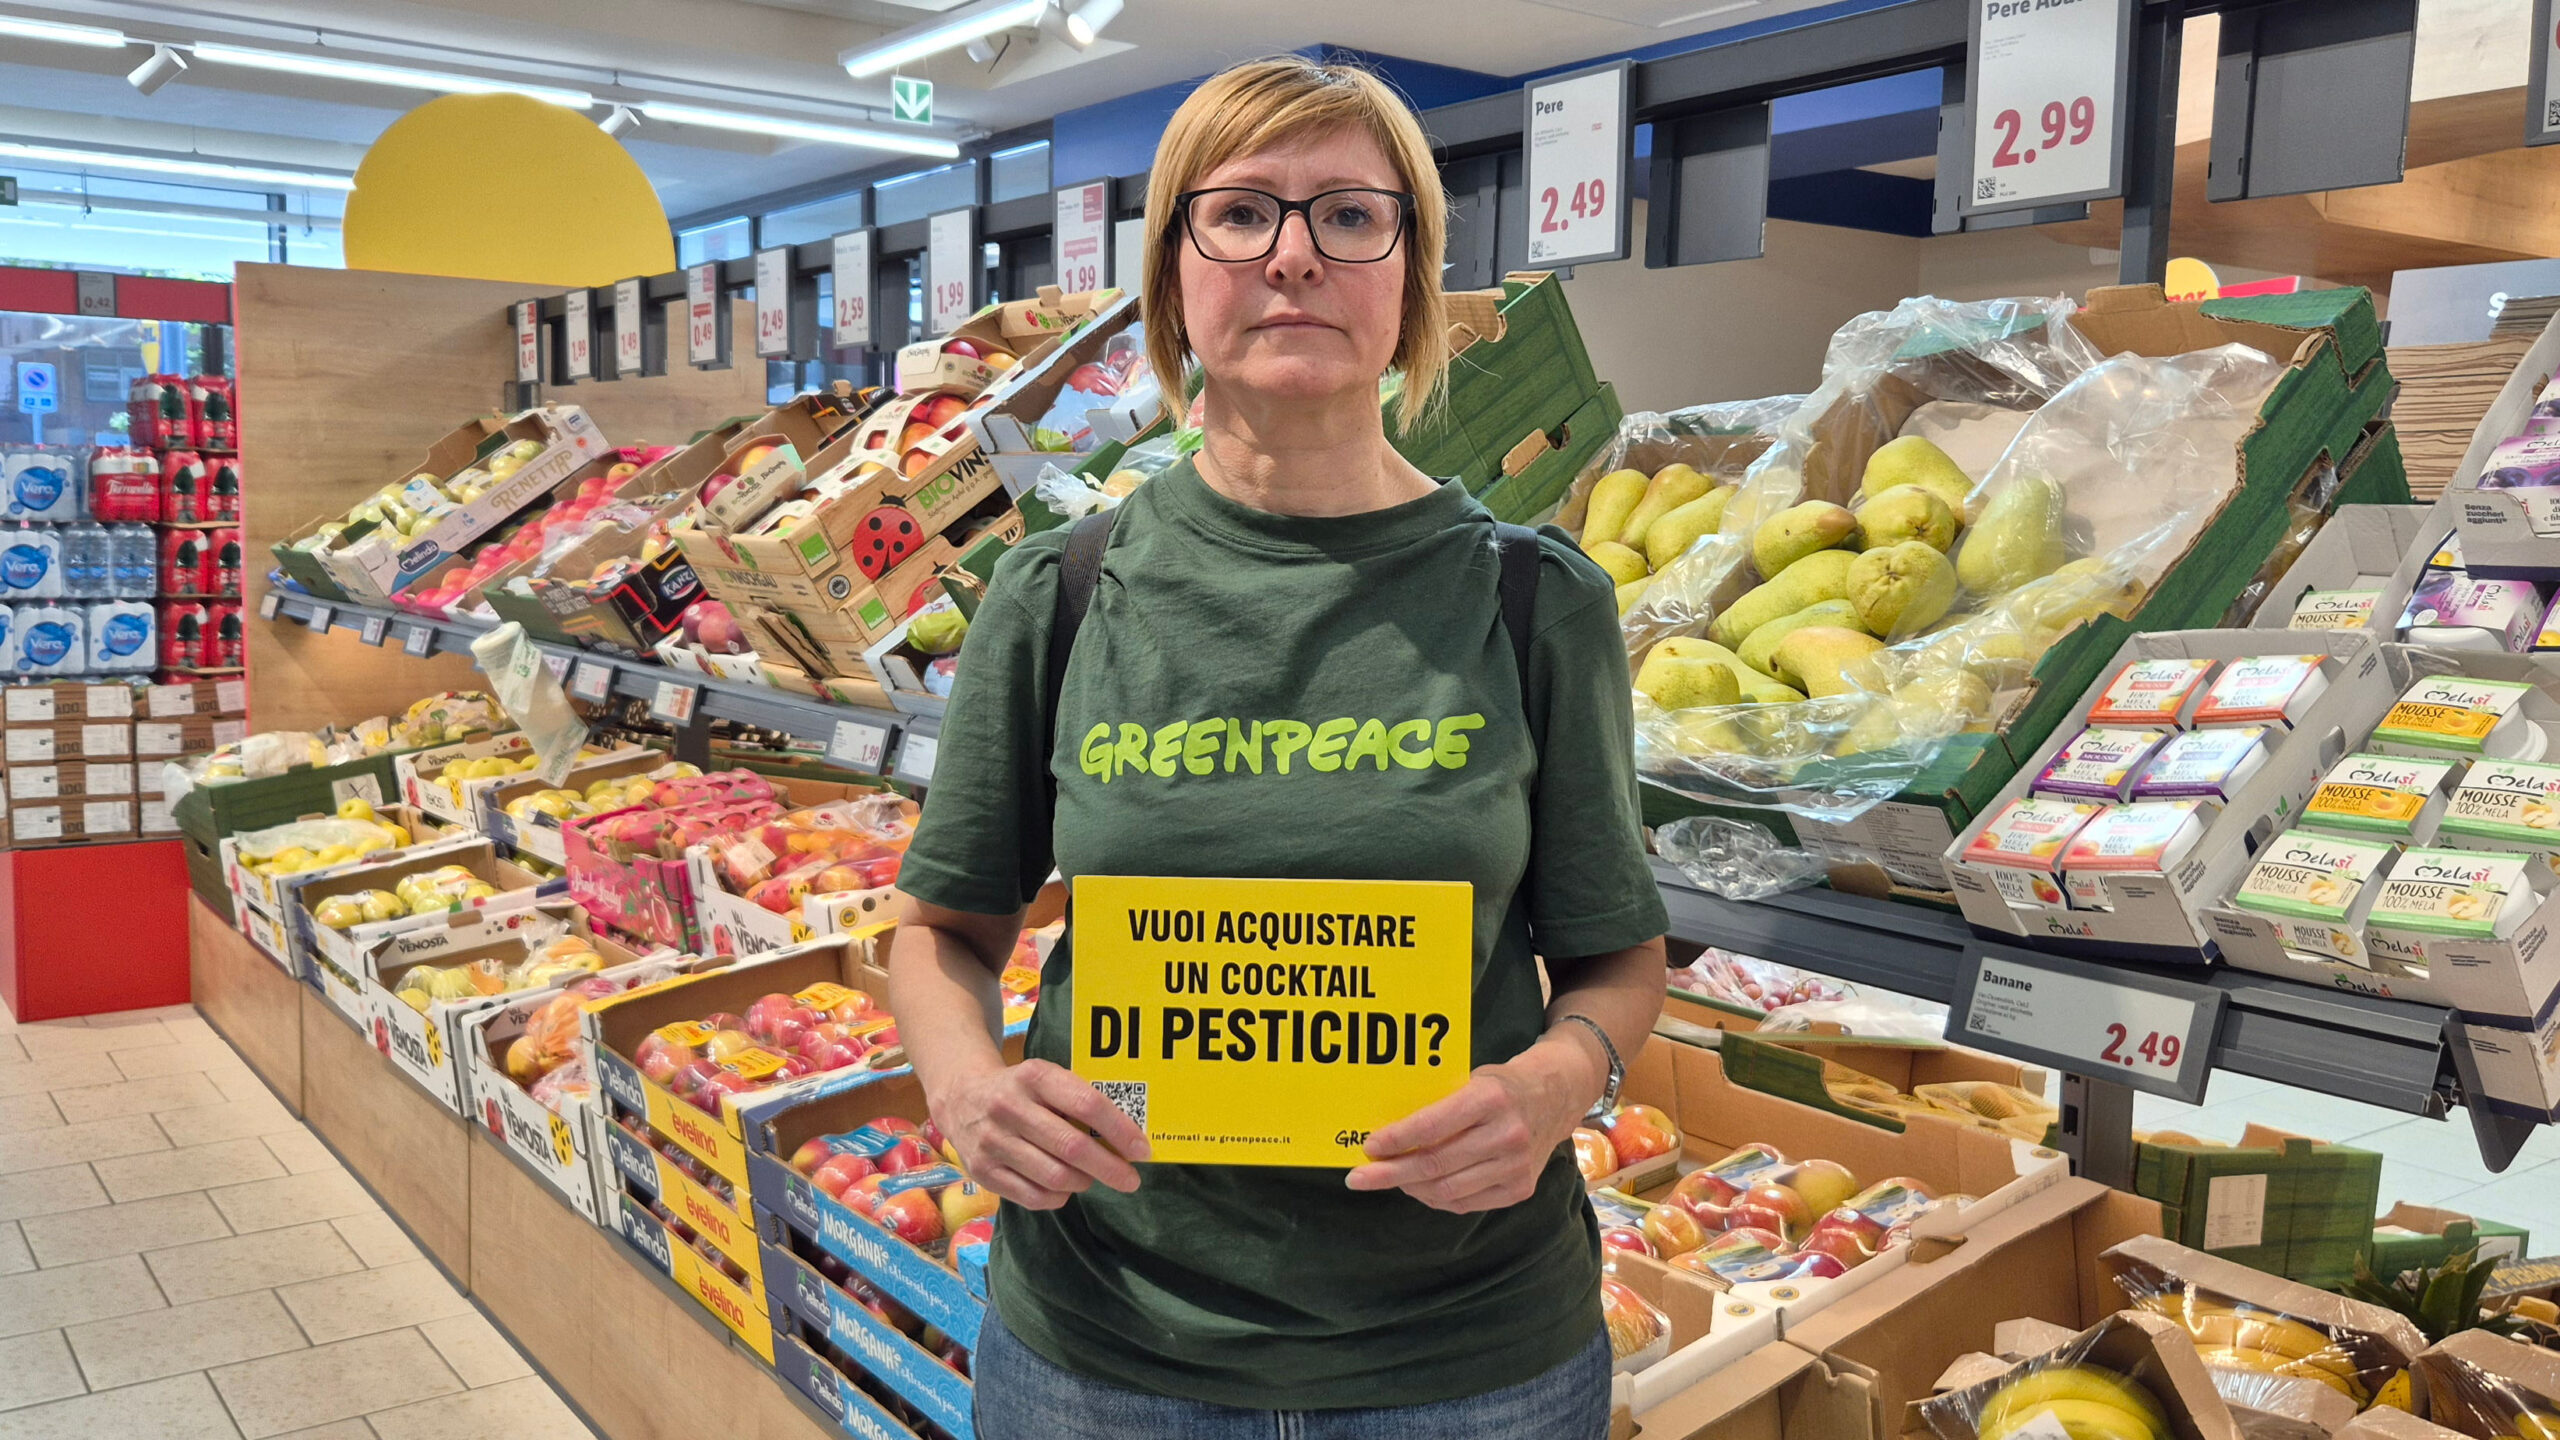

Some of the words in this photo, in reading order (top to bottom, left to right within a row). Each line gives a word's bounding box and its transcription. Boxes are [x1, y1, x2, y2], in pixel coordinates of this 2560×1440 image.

[1987, 0, 2030, 20] Pere
[1536, 100, 1563, 116] Pere
[1992, 96, 2095, 168] 2.99
[1540, 179, 1605, 233] 2.49
[1065, 265, 1096, 294] 1.99
[937, 281, 964, 314] 1.99
[762, 309, 784, 337] 2.49
[840, 296, 864, 327] 2.59
[621, 332, 637, 356] 1.49
[694, 322, 712, 346] 0.49
[572, 339, 586, 362] 1.99
[21, 481, 55, 494] Vera
[6, 560, 40, 573] Vera
[401, 540, 438, 570] Melinda
[664, 570, 696, 596] KANZI
[2296, 614, 2342, 624] MOUSSE
[31, 638, 65, 651] Vera
[109, 629, 142, 641] Vera
[2388, 713, 2414, 725] 100%
[2415, 716, 2435, 724] MELA
[2394, 703, 2450, 718] MOUSSE
[861, 743, 879, 763] 1.99
[1079, 712, 1486, 784] GREENPEACE
[2082, 753, 2121, 761] MOUSSE
[2320, 784, 2375, 801] MOUSSE
[2341, 797, 2362, 807] MELA
[2460, 789, 2521, 808] MOUSSE
[2455, 802, 2482, 816] 100%
[2484, 806, 2509, 819] MELA
[2002, 838, 2030, 847] MELA
[2251, 877, 2275, 892] 100%
[2277, 882, 2298, 895] MELA
[2256, 865, 2311, 884] MOUSSE
[1998, 882, 2025, 893] MELA
[2001, 890, 2024, 900] PESCA
[2386, 882, 2447, 900] MOUSSE
[2382, 895, 2408, 909] 100%
[2409, 899, 2435, 912] MELA
[731, 909, 746, 928] VAL
[1129, 909, 1205, 943] VUOI
[1215, 911, 1416, 951] ACQUISTARE
[2294, 925, 2326, 940] MOUSSE
[398, 936, 449, 954] VENOSTA
[1165, 961, 1208, 994] UN
[1222, 963, 1376, 998] COCKTAIL
[1983, 970, 2032, 991] Banane
[389, 1019, 428, 1069] VENOSTA
[1090, 1005, 1140, 1058] DI
[1162, 1007, 1450, 1066] PESTICIDI?
[2100, 1022, 2181, 1067] 2.49
[599, 1057, 646, 1111] Melinda
[500, 1090, 513, 1114] VAL
[503, 1107, 552, 1165] VENOSTA
[671, 1109, 719, 1160] evelina
[1204, 1134, 1216, 1142] su
[1219, 1134, 1291, 1145] greenpeace.it
[608, 1132, 657, 1190] Melinda
[685, 1190, 731, 1246] evelina
[787, 1190, 820, 1223] Melinda
[621, 1207, 670, 1267] Melinda
[699, 1274, 745, 1329] evelina
[799, 1283, 832, 1319] Melinda
[810, 1375, 844, 1414] Melinda
